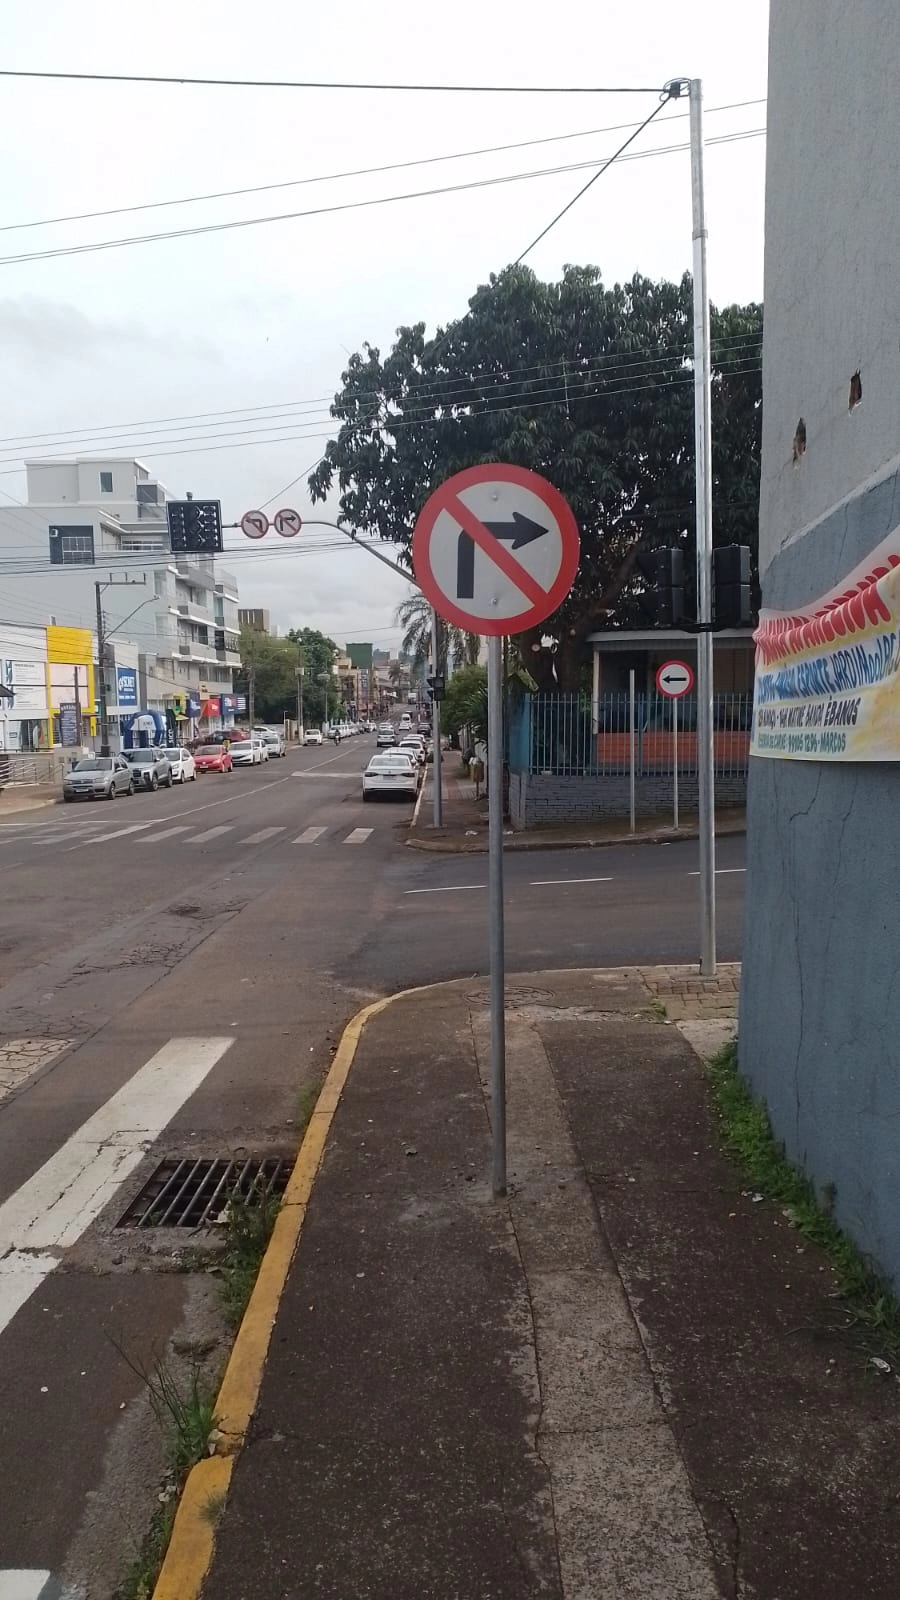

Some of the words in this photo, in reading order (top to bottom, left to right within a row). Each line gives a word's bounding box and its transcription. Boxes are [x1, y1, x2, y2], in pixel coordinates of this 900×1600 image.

[830, 645, 868, 692] JARDIM
[824, 696, 861, 727] ÉBANOS
[820, 732, 846, 754] MARCOS
